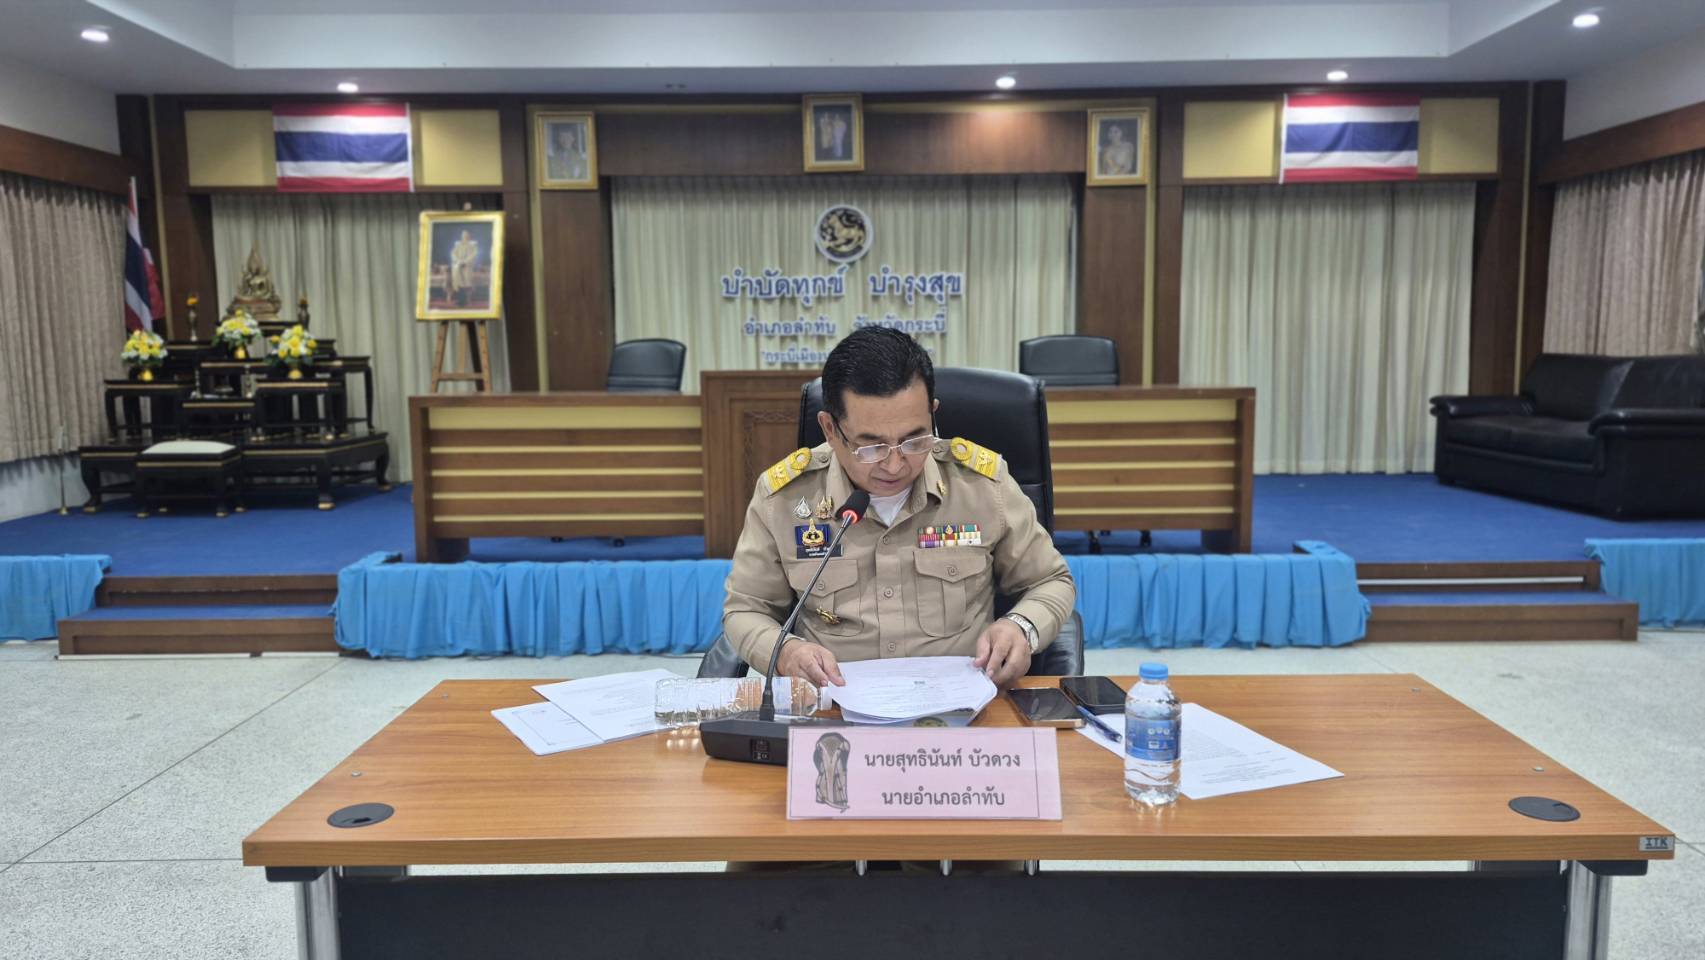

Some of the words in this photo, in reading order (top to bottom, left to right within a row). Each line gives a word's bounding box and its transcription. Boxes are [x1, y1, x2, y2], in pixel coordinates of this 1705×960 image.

[722, 266, 847, 305] บำบัดทุกข์
[869, 266, 963, 304] บำรุงสุข
[744, 316, 836, 335] อำเภอลำทับ
[864, 747, 963, 773] นายสุทธินันท์
[968, 747, 1021, 767] บัวดวง
[881, 785, 1006, 806] นายอำเภอลำทับ
